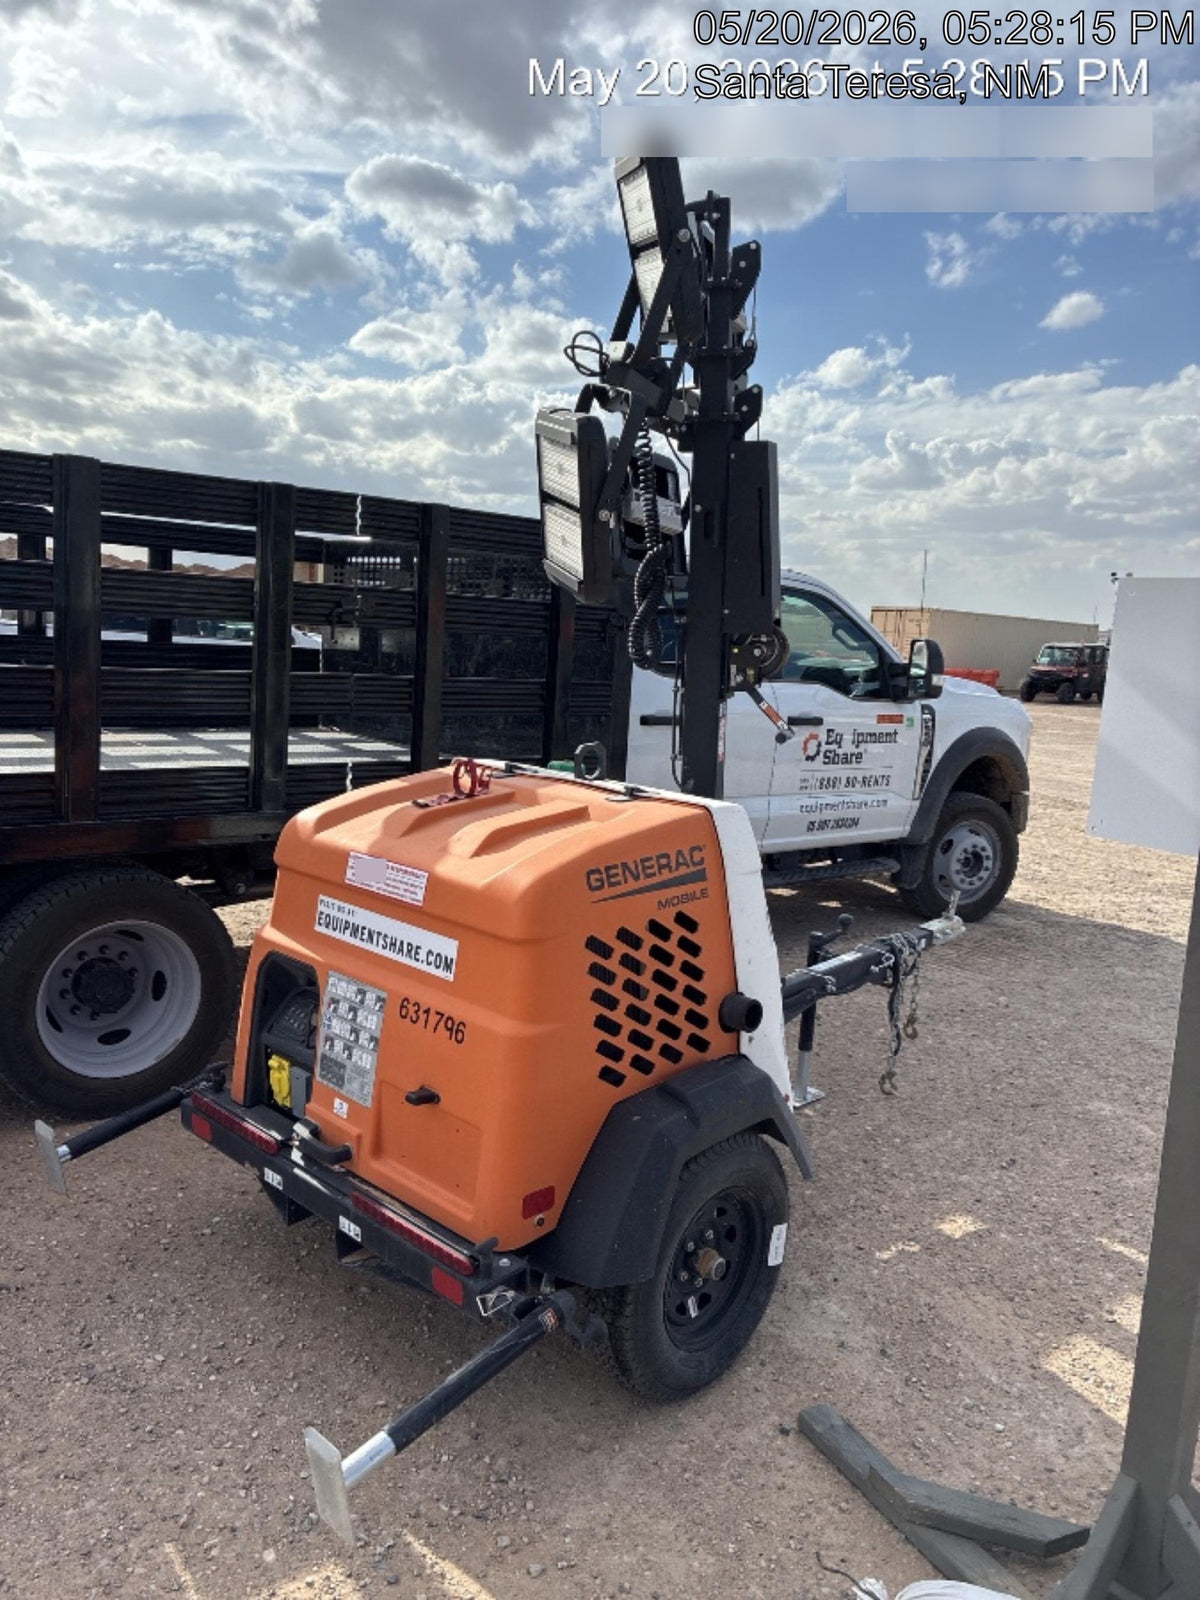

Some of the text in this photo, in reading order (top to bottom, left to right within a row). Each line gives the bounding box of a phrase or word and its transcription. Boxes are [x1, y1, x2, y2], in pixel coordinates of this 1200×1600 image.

[825, 728, 899, 749] Eqipment
[823, 749, 864, 766] Share
[799, 799, 888, 815] equipmentshare.com
[586, 844, 705, 892] GENERAC
[657, 888, 709, 910] MOBILE
[317, 911, 455, 975] EQUIPMENTSHARE.COM
[399, 997, 467, 1045] 631796
